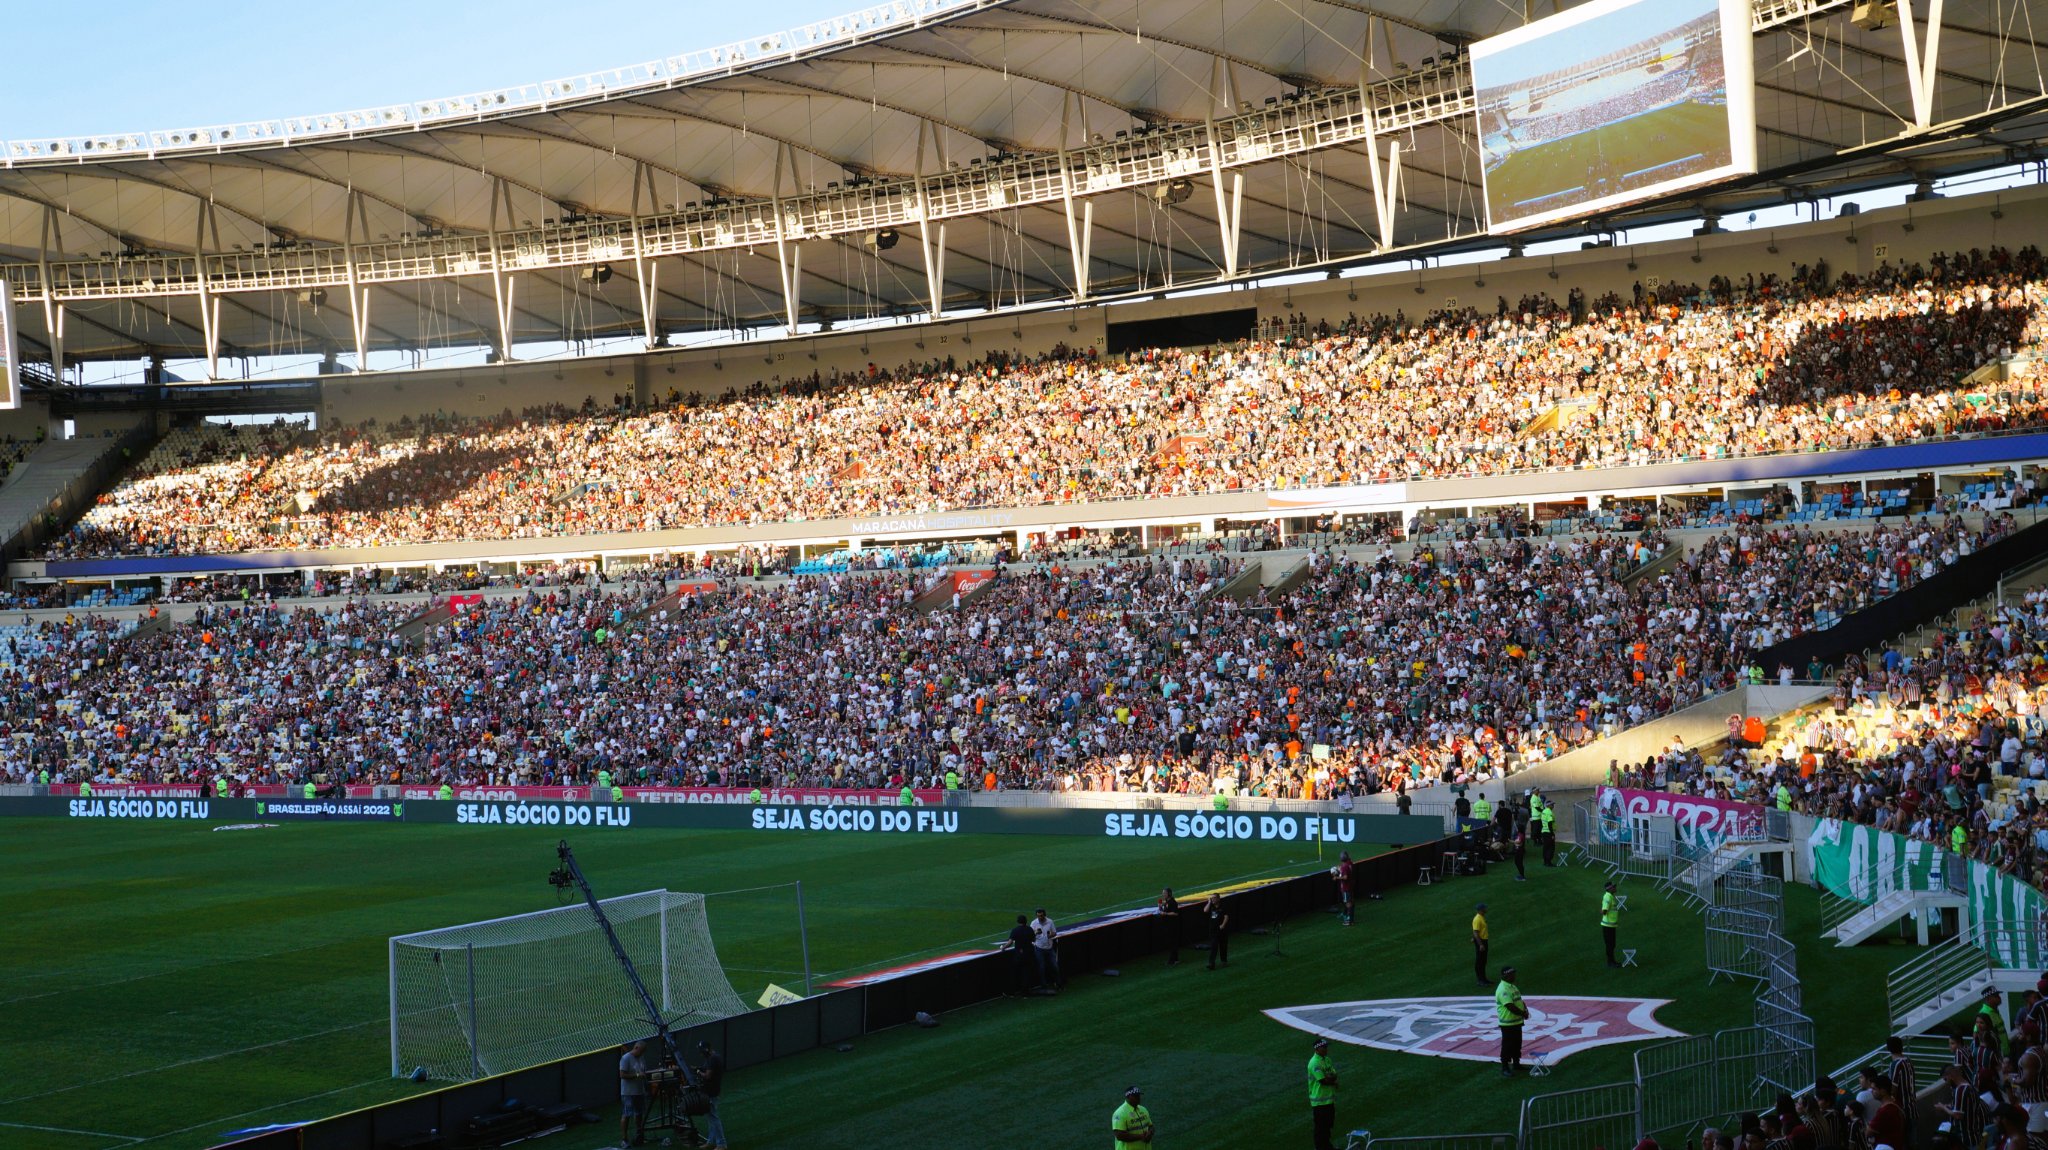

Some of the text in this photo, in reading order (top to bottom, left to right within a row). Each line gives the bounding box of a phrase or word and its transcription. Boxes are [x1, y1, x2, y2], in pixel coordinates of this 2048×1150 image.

[1876, 247, 1886, 256] 27
[1648, 278, 1658, 287] 28
[1446, 299, 1456, 307] 29
[852, 514, 1013, 533] MARACANÃ HOSPITALITY
[70, 797, 209, 819] SEJA SÓCIO DO FLU
[269, 803, 390, 815] BRASILEIRÃO ASSAÍ 2022
[457, 800, 630, 827] SEJA SÓCIO DO FLU
[752, 804, 958, 833] SEJA SÓCIO DO FLU
[1105, 809, 1355, 842] SEJA SÓCIO DO FLU
